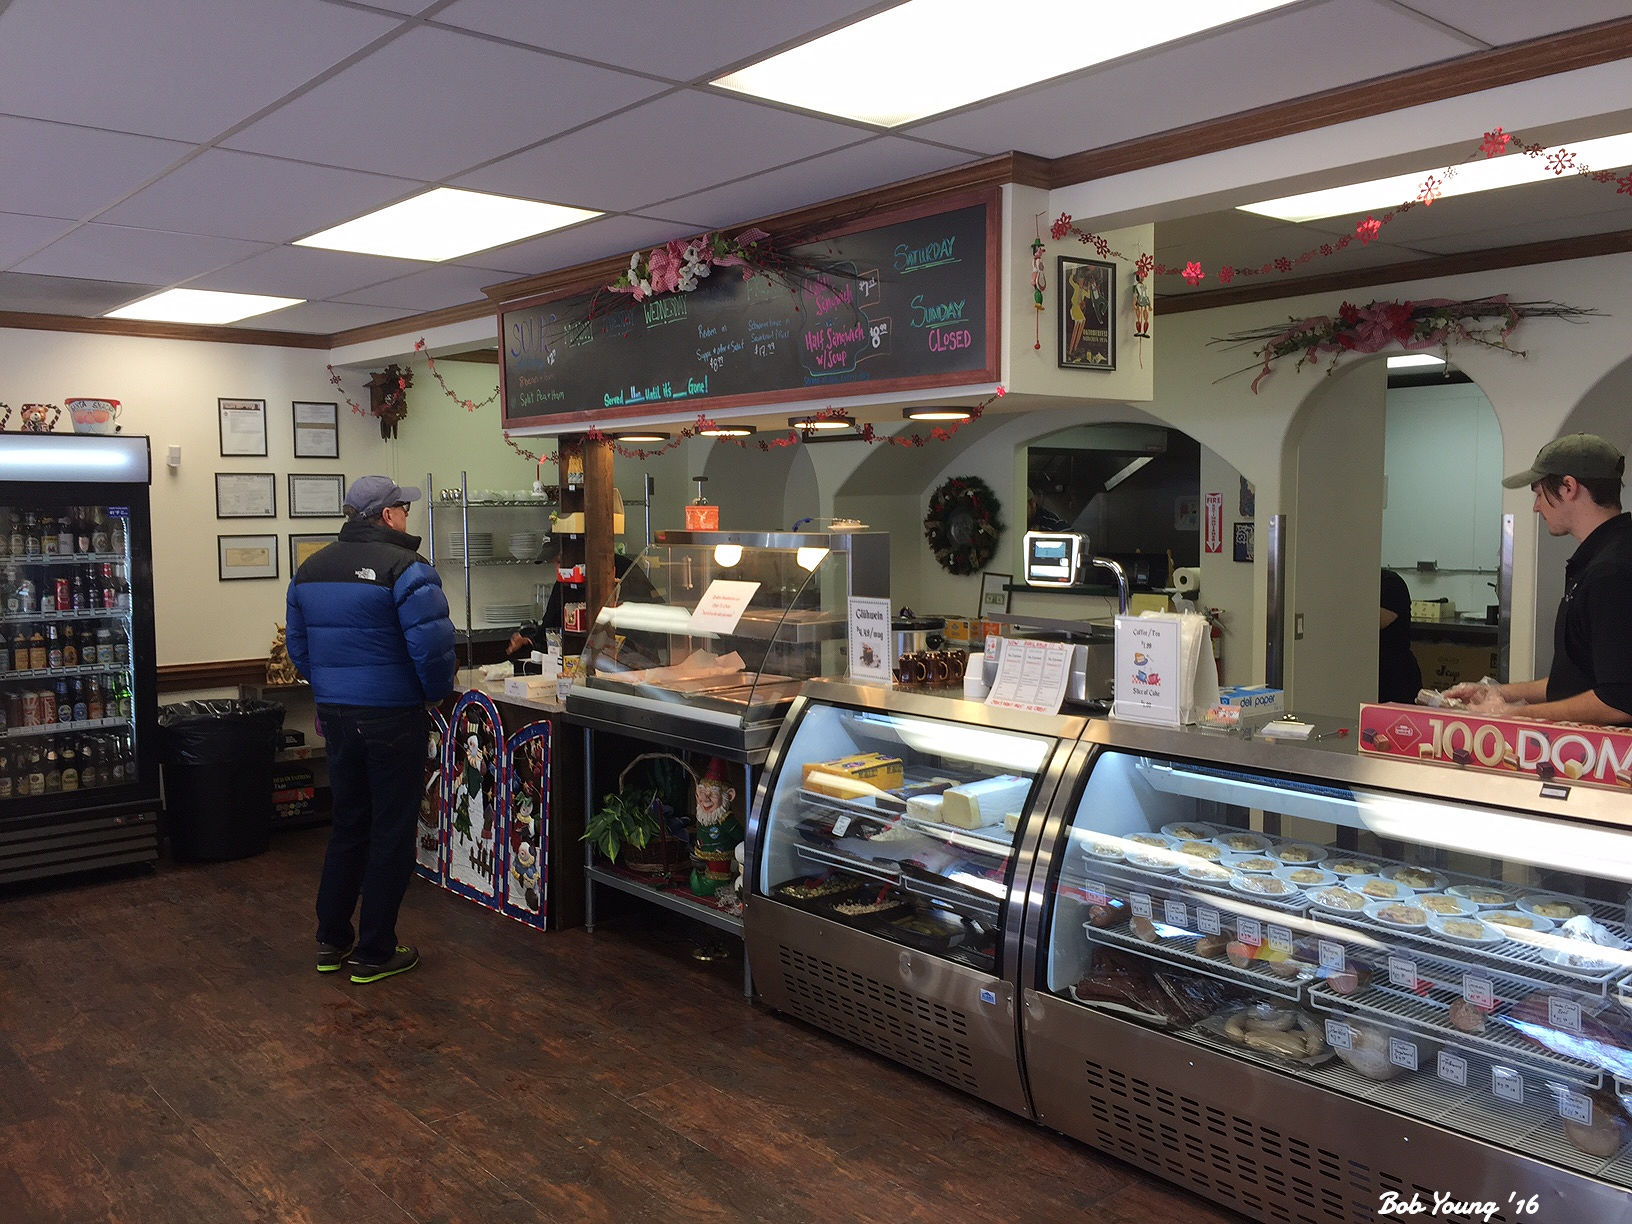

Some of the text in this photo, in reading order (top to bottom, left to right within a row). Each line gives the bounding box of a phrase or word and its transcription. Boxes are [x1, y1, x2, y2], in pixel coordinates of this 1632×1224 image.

[893, 236, 956, 270] SATURDAY
[910, 294, 966, 328] SUNDAY
[804, 329, 824, 352] Half
[928, 328, 972, 352] CLOSED
[603, 389, 624, 408] Served
[645, 384, 661, 401] Until
[688, 375, 709, 396] Gone!
[855, 608, 884, 621] Glühwein
[1240, 694, 1275, 708] deli paper
[1429, 718, 1506, 768] 100
